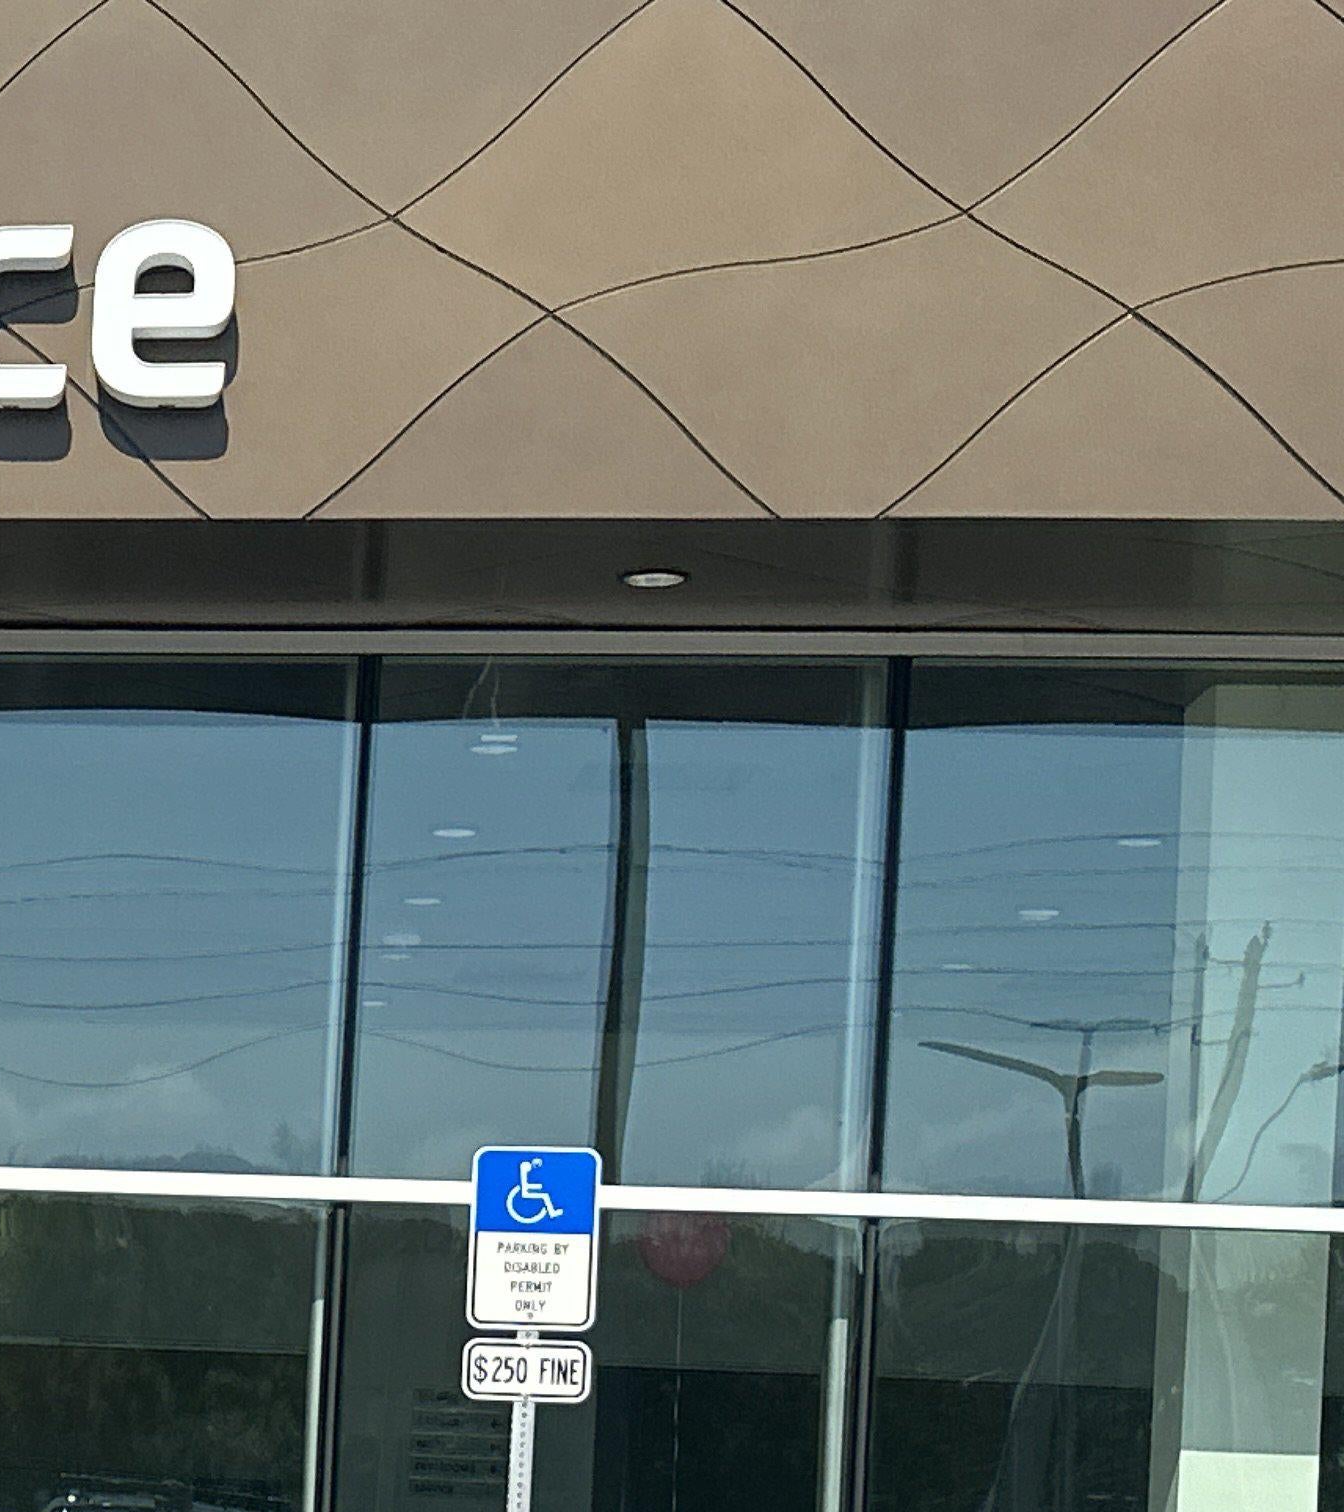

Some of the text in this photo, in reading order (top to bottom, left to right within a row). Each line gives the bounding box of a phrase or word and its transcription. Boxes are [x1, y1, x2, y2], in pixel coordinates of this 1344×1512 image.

[497, 1241, 570, 1255] PARKING BY
[504, 1261, 560, 1274] DISABLED
[511, 1280, 552, 1293] PERMIT
[515, 1300, 546, 1312] ONLY
[473, 1354, 580, 1385] $250 FINE
